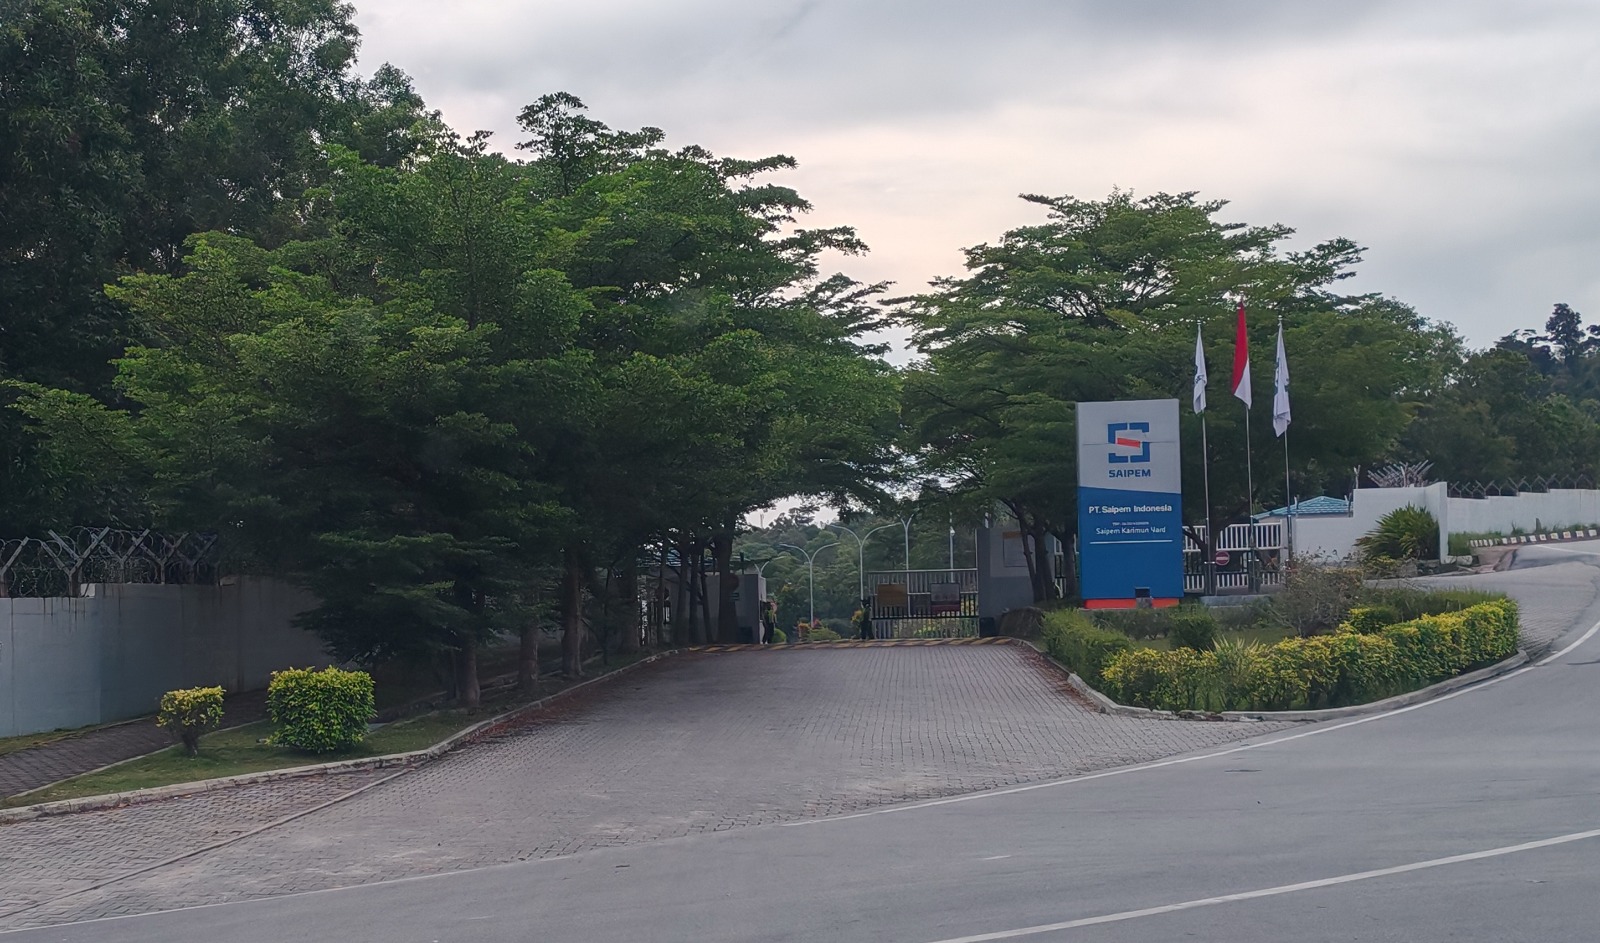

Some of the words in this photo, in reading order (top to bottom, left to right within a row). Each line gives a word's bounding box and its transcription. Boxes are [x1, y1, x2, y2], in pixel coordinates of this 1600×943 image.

[1108, 469, 1151, 478] SAIPEM
[1101, 505, 1131, 514] Saipem
[1133, 504, 1172, 512] Indonesia
[1096, 527, 1120, 535] Saipem
